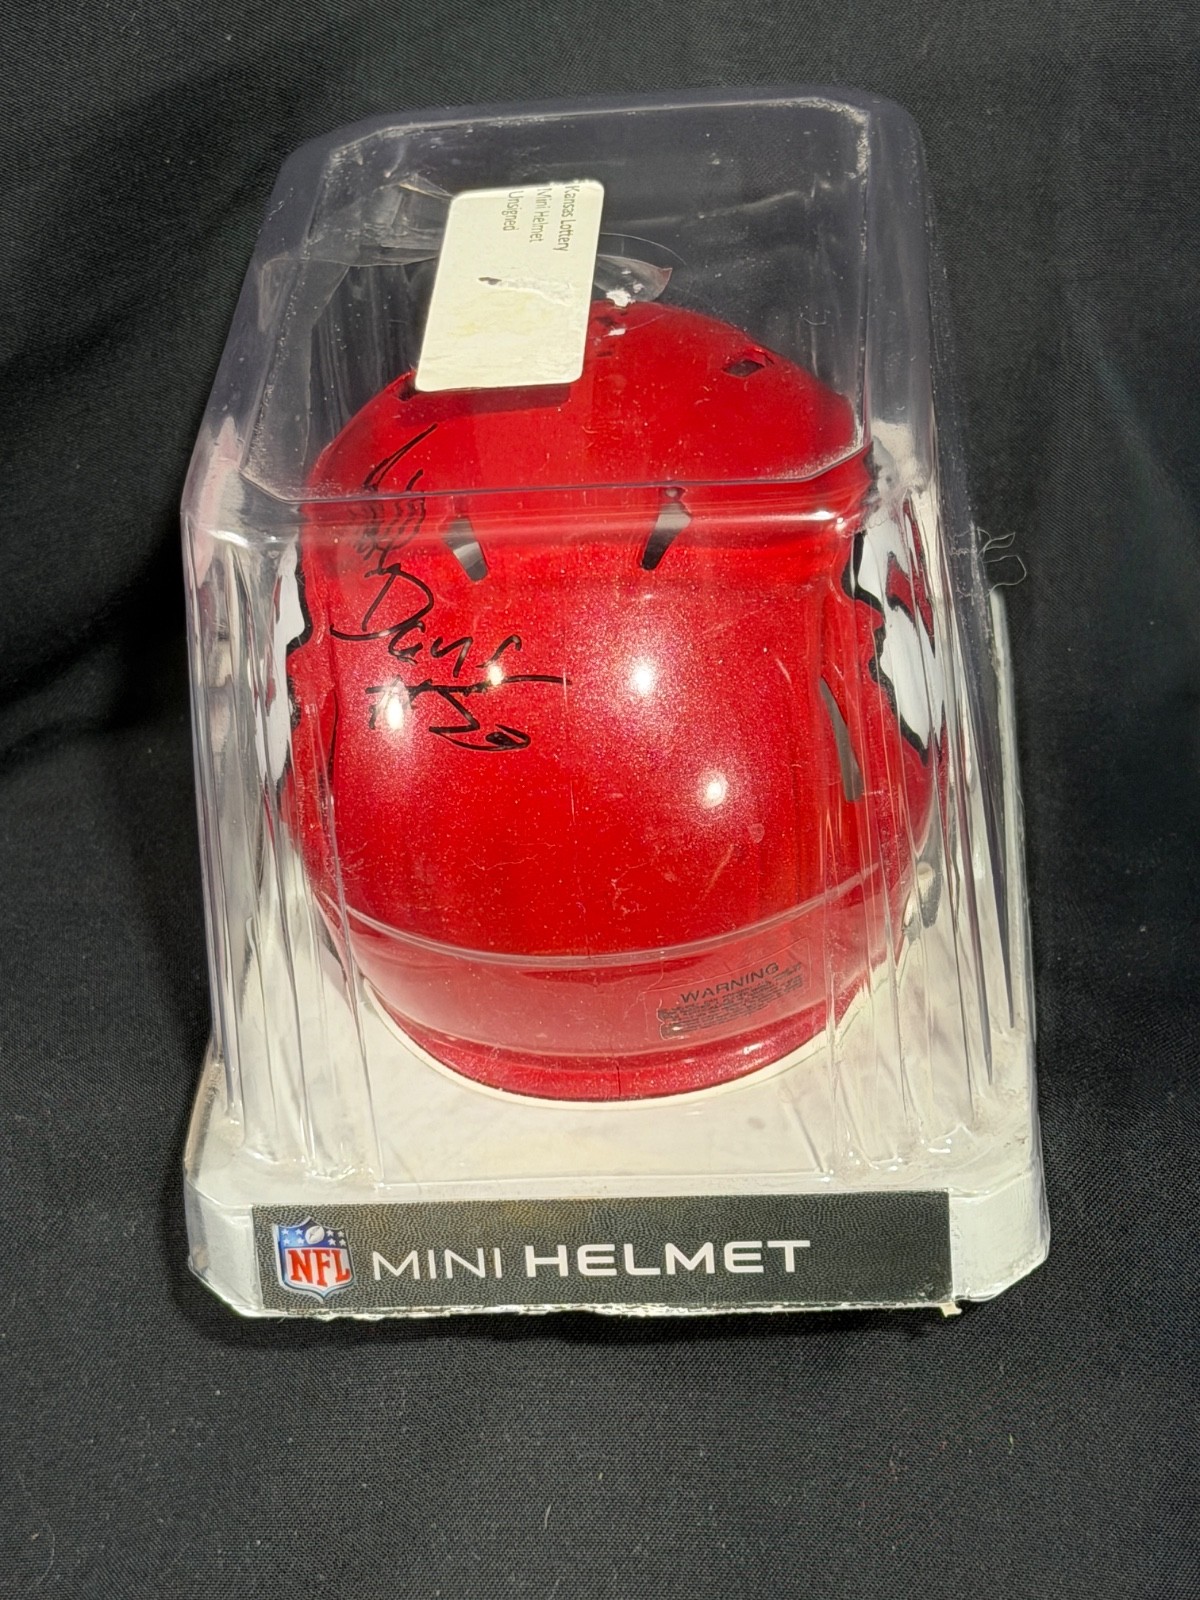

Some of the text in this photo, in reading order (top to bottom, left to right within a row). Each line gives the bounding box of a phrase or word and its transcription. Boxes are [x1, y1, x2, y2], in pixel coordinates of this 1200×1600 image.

[501, 190, 524, 231] Unsigned
[529, 187, 552, 243] Mini Helmet
[553, 185, 580, 252] Kansas Lottery
[681, 962, 779, 1003] WARNING
[287, 1248, 350, 1287] NFL
[373, 1240, 811, 1280] MINI HELMET
